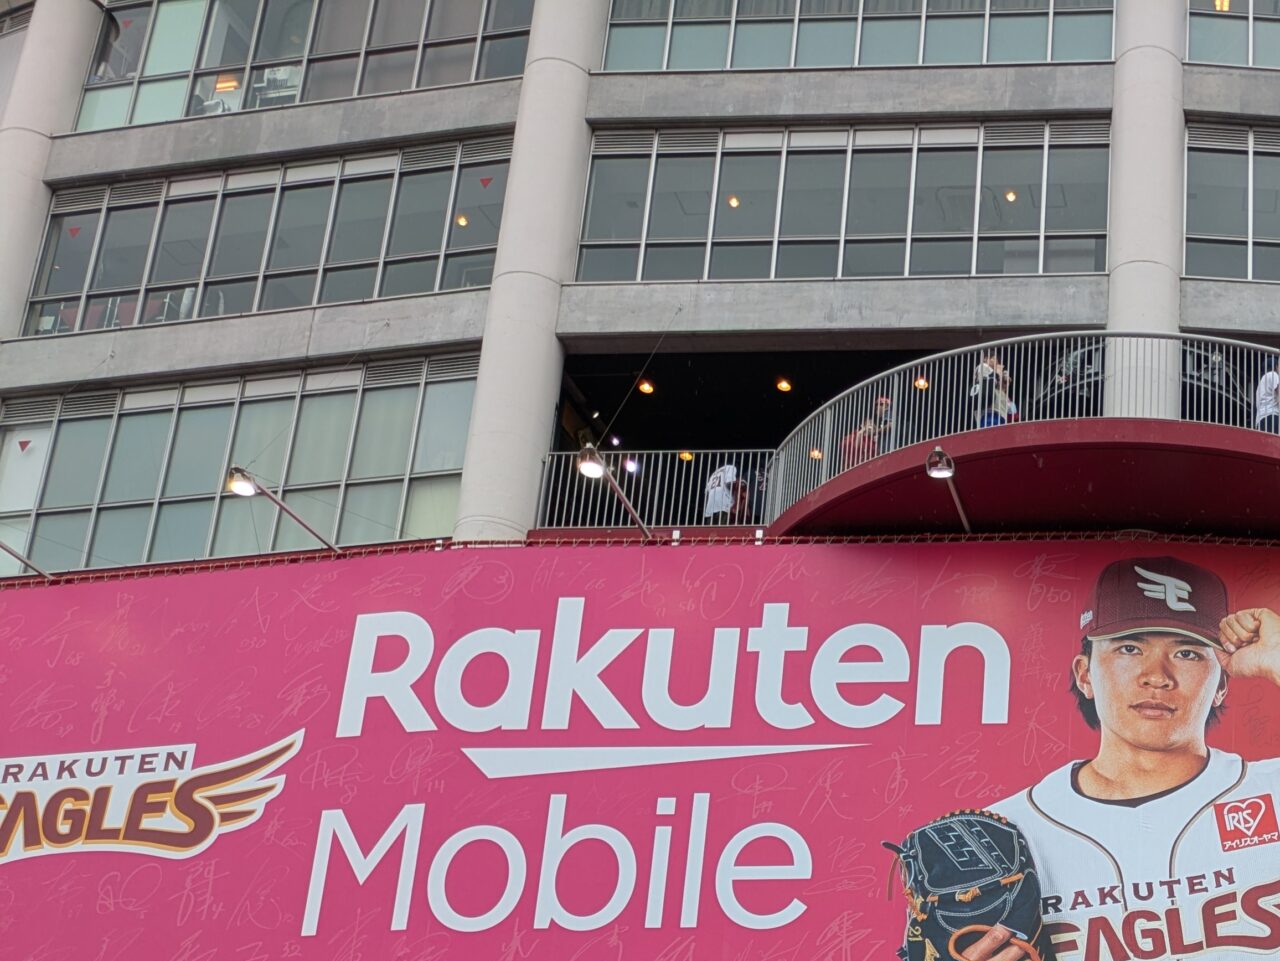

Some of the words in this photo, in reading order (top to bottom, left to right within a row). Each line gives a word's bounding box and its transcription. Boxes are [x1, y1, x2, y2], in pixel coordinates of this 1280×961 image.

[336, 597, 1010, 738] Rakuten
[2, 750, 188, 784] RAKUTEN
[0, 752, 278, 853] AGLES
[1225, 808, 1256, 833] IRIS
[302, 793, 812, 936] Mobile
[1223, 831, 1279, 850] アイリスオーヤマ
[1042, 867, 1236, 915] RAKUTEN
